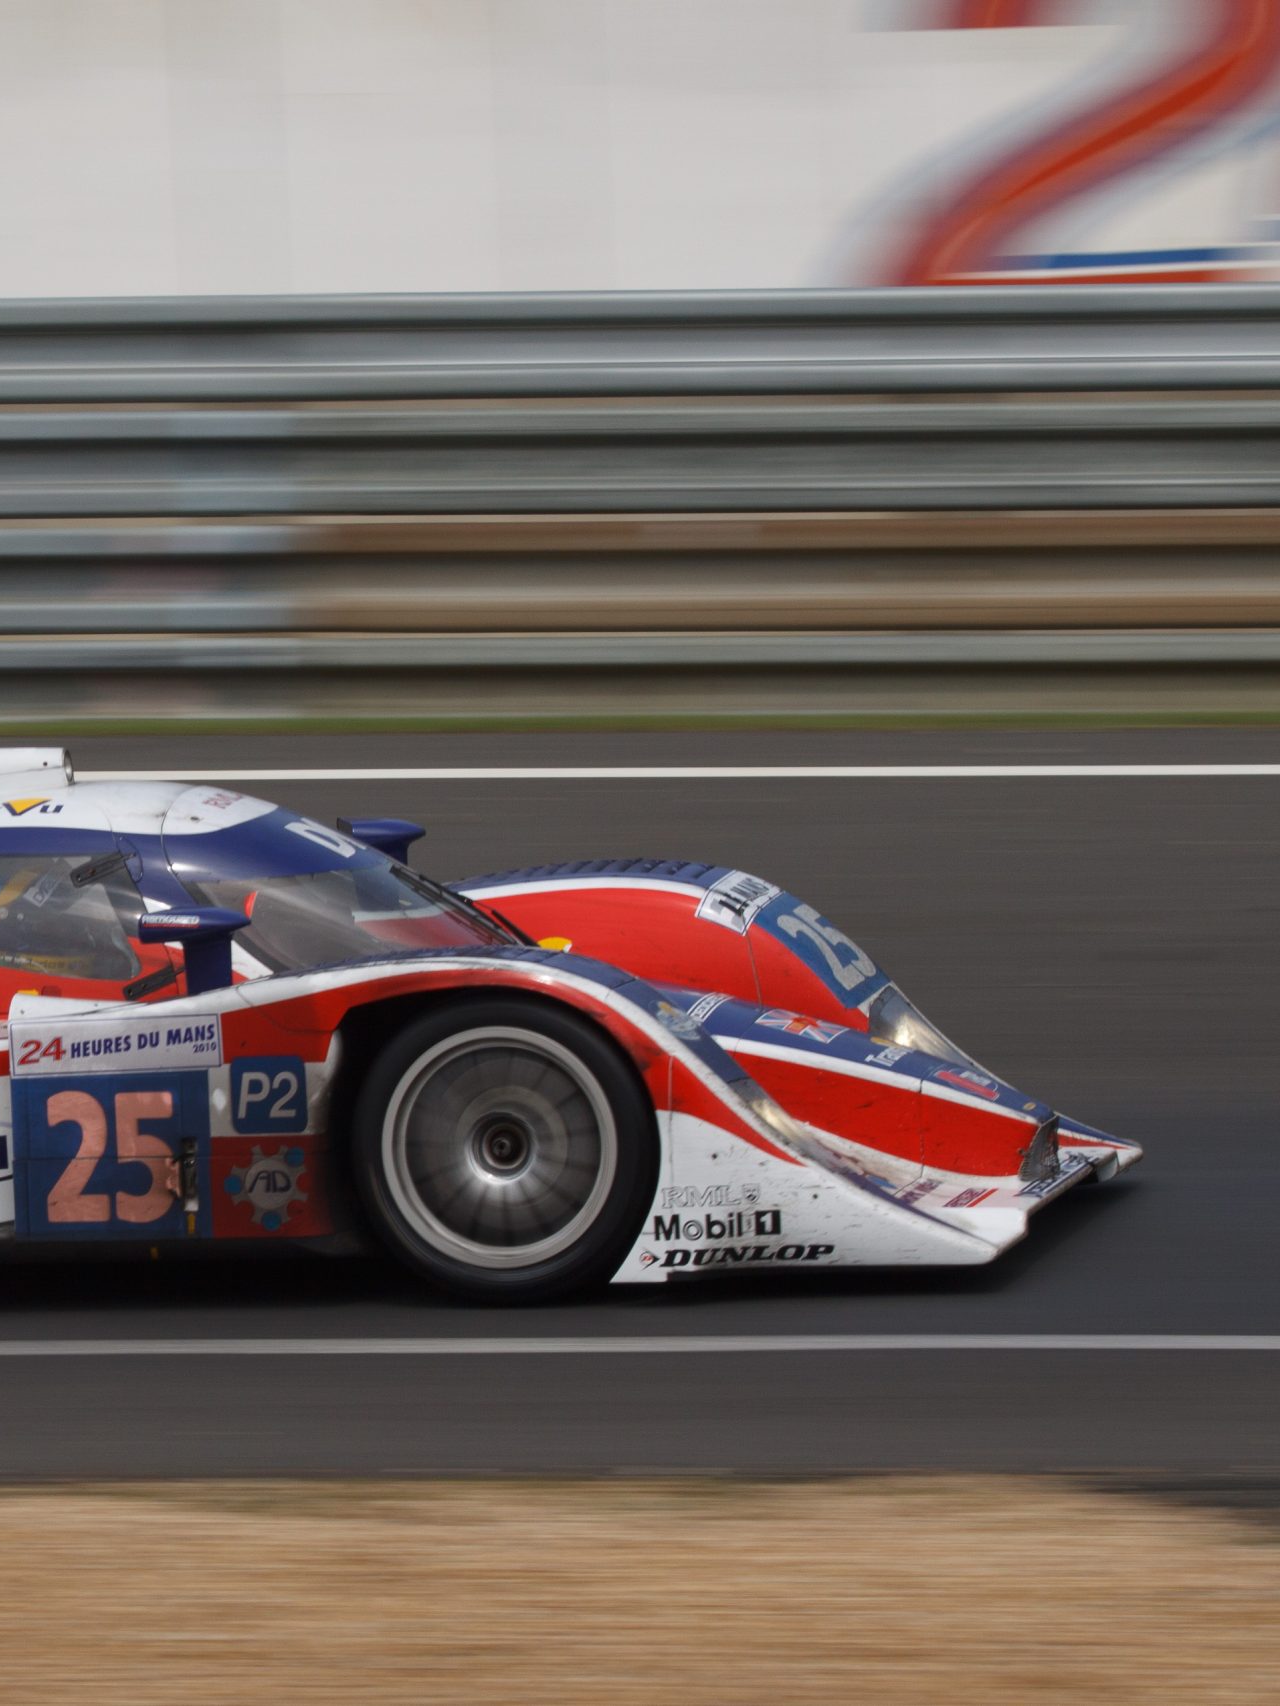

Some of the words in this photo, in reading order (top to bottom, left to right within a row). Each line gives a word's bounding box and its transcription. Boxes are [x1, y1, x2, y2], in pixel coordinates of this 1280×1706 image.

[777, 903, 877, 991] 25
[17, 1036, 66, 1066] 24
[71, 1035, 132, 1060] HEURES
[137, 1030, 160, 1049] DU
[166, 1024, 215, 1046] MANS
[192, 1041, 217, 1054] 2010
[237, 1071, 299, 1119] P2
[47, 1090, 179, 1223] 25
[661, 1184, 741, 1209] RML
[654, 1211, 743, 1242] Mobil
[757, 1211, 778, 1236] 1
[660, 1245, 835, 1267] DUNLOP
